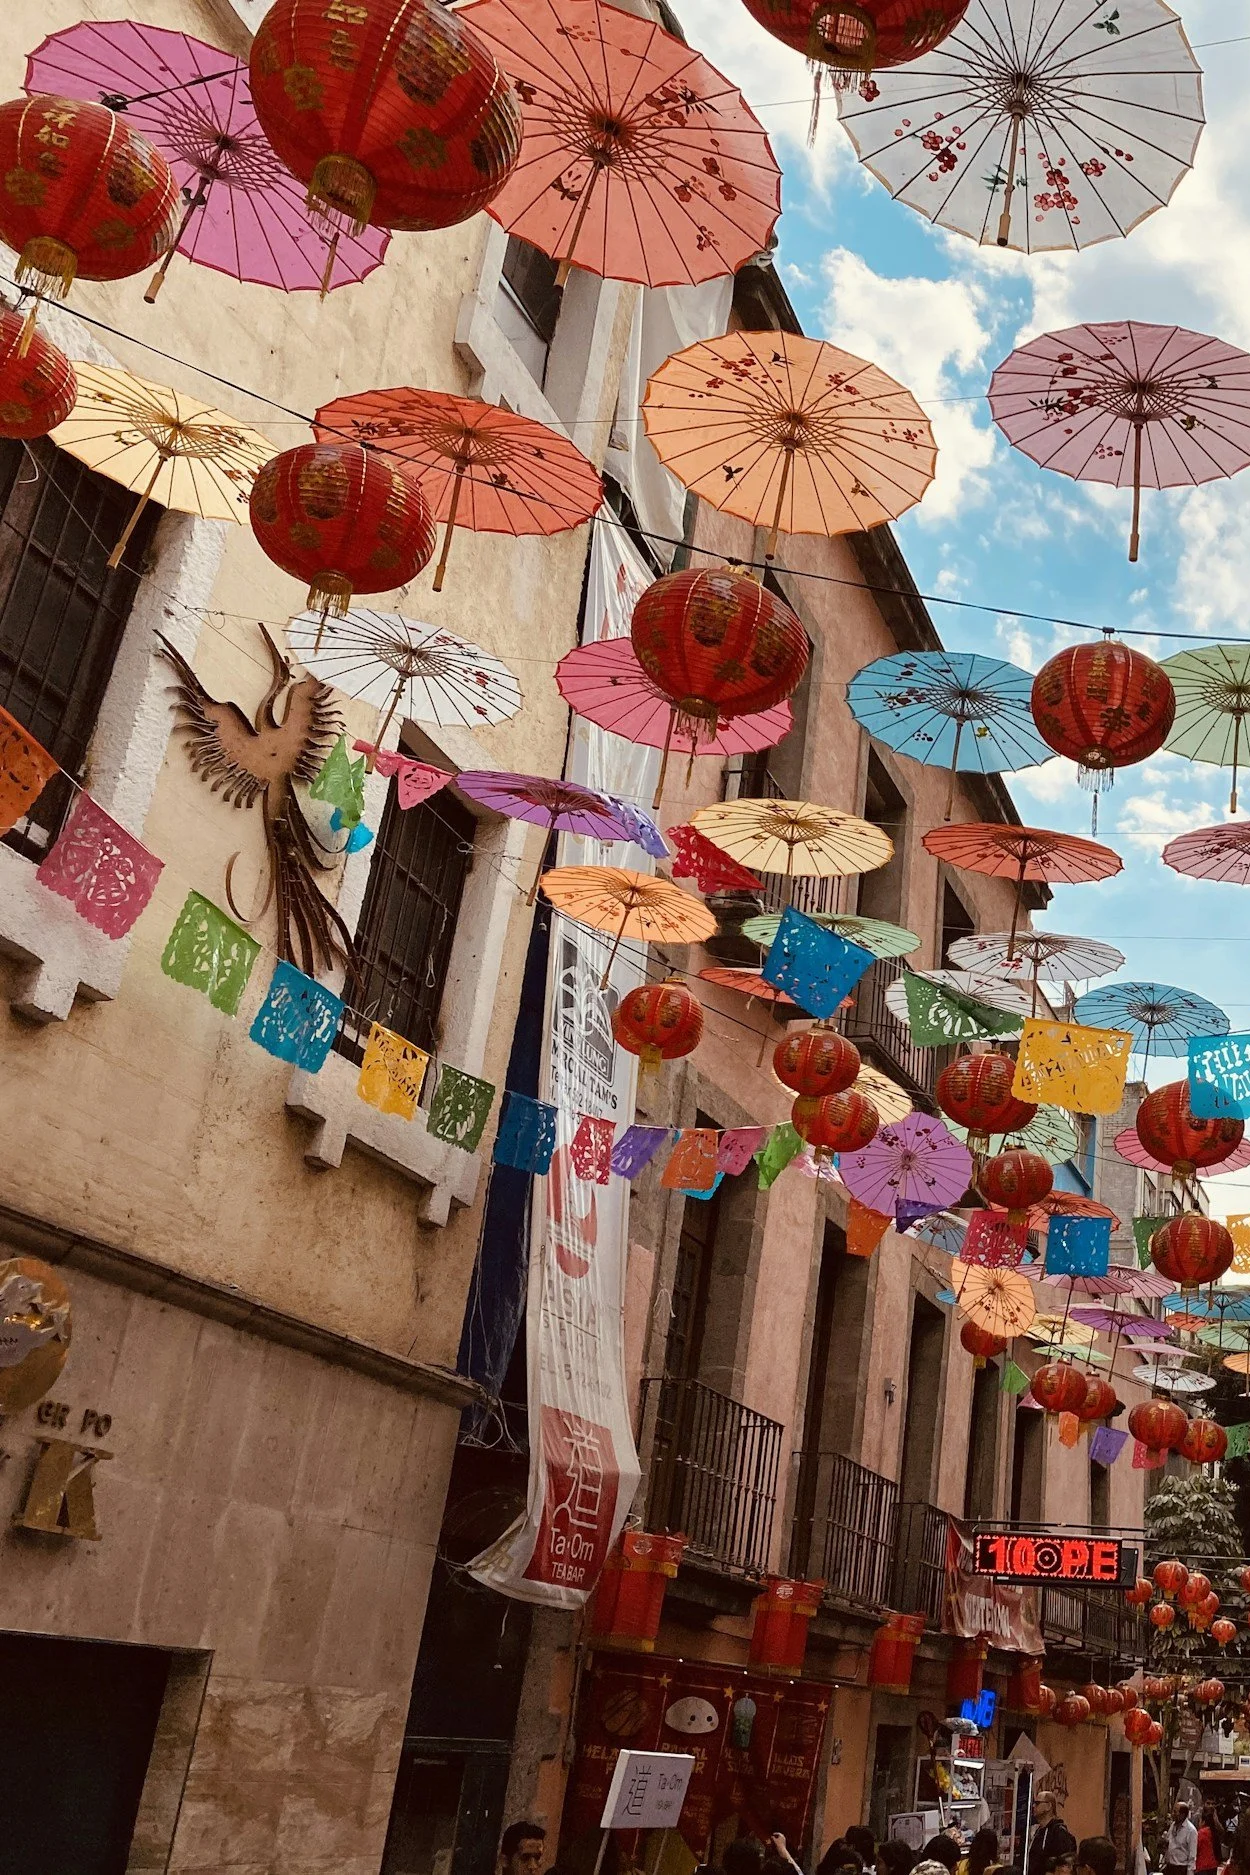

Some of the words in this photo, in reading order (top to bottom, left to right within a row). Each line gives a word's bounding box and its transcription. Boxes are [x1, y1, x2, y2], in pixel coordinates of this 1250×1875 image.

[589, 1076, 618, 1110] TAM'S
[988, 1537, 1035, 1576] 10
[1061, 1541, 1118, 1580] PE
